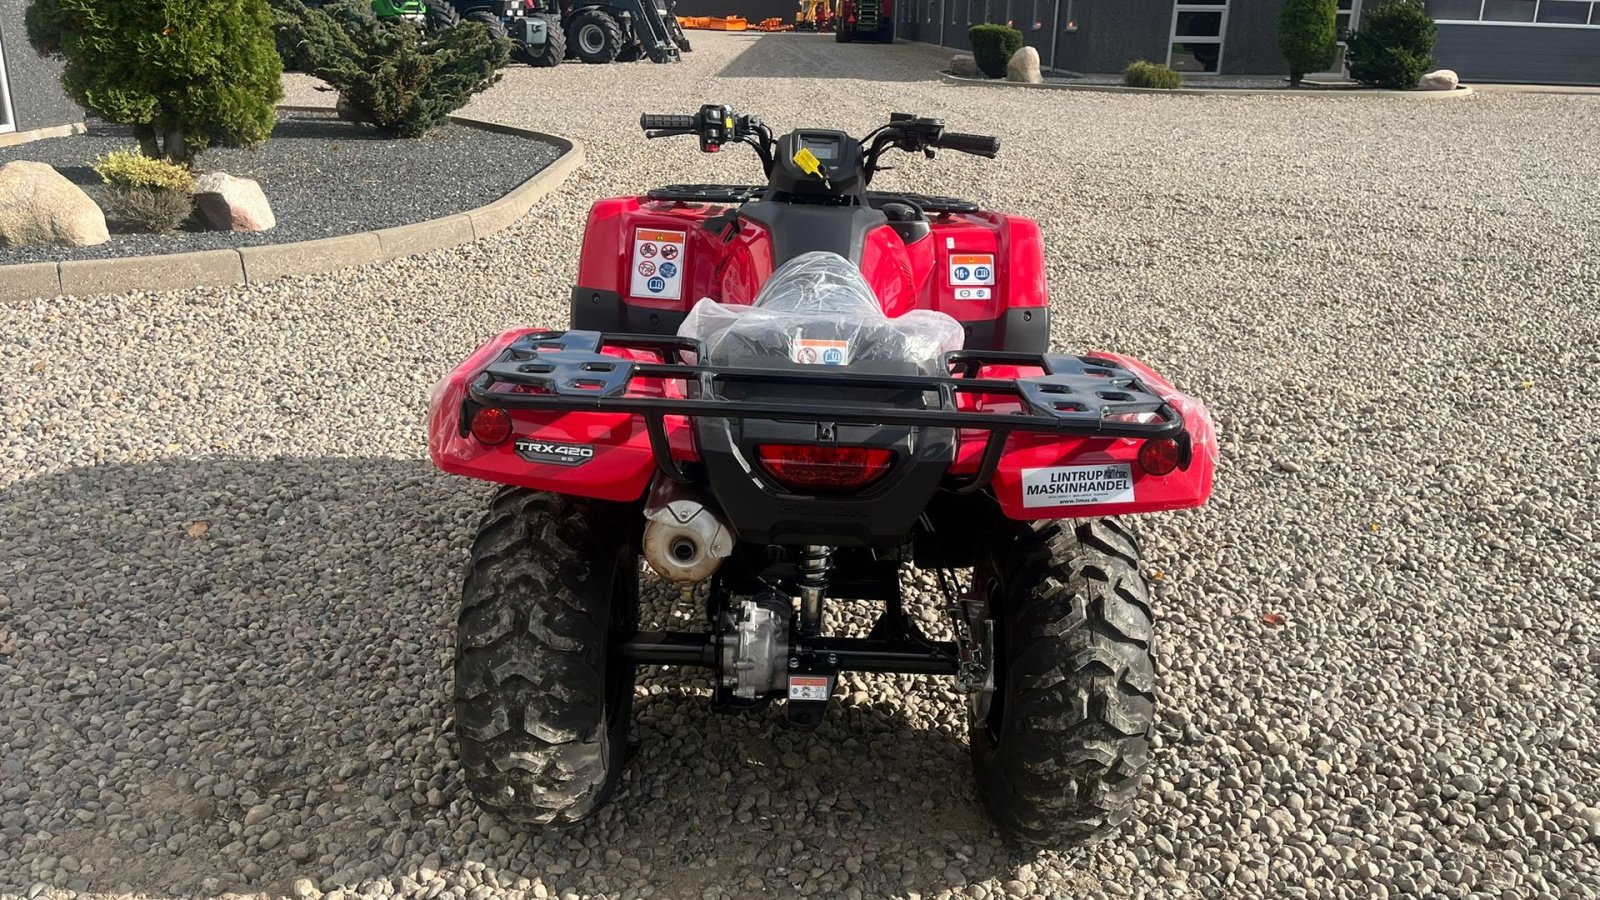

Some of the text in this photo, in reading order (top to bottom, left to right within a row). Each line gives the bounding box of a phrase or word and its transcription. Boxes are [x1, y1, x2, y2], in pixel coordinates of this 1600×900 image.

[515, 441, 593, 457] TRX420
[1050, 470, 1104, 483] LINTRUP
[1027, 480, 1130, 495] MASKINHANDEL
